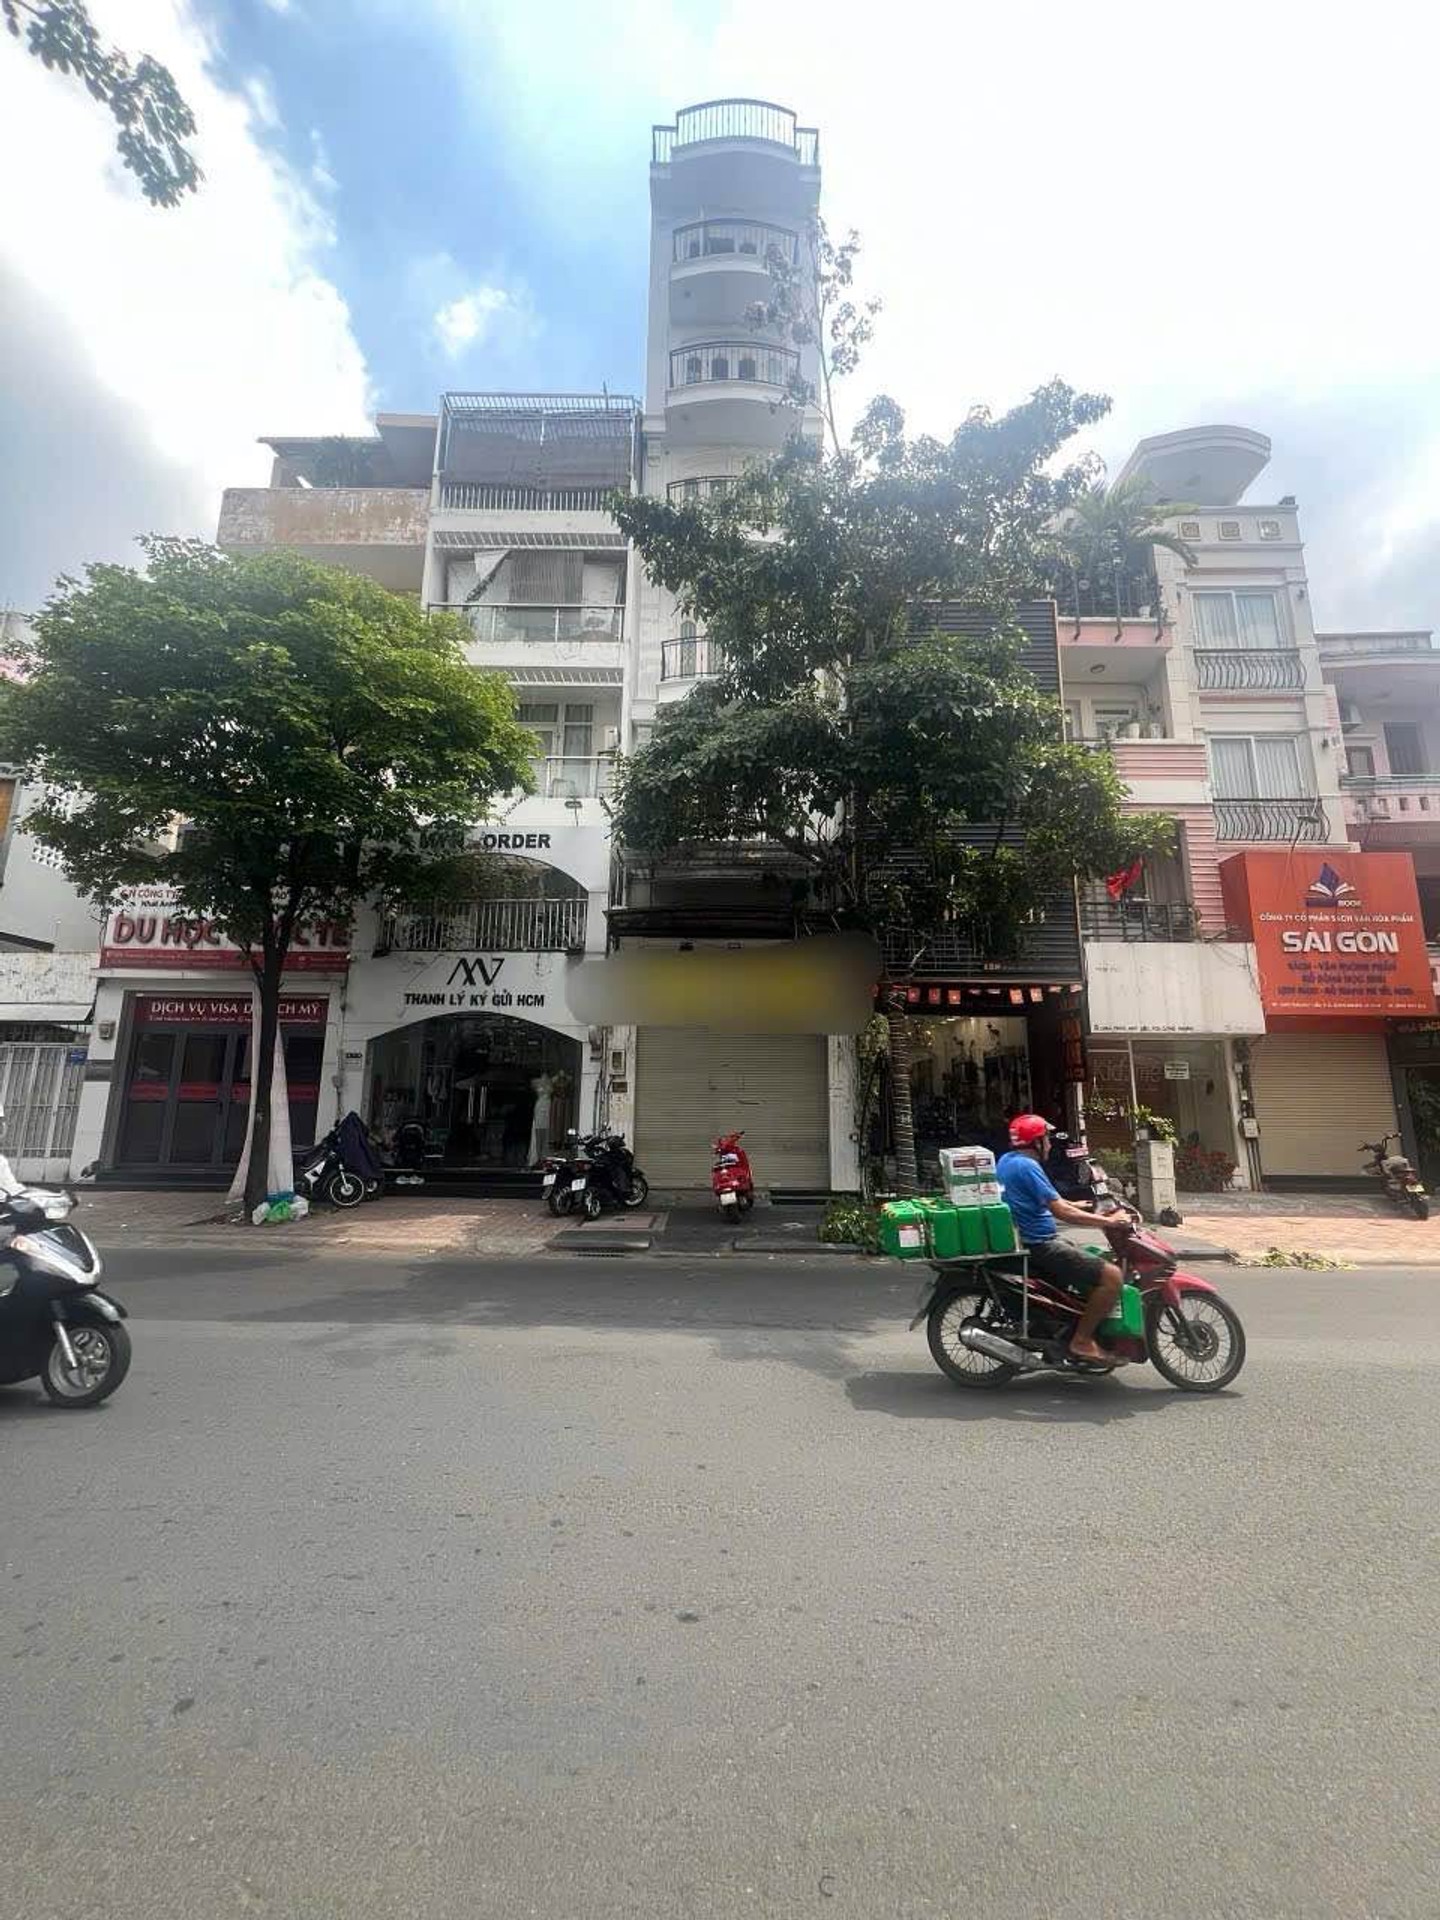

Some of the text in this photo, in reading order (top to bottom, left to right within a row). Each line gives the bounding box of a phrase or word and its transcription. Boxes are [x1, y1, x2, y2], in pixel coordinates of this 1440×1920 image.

[482, 834, 551, 849] ORDER
[161, 917, 220, 949] HỌC
[404, 993, 446, 1006] THANH
[449, 990, 467, 1006] LÝ
[470, 990, 488, 1006] KÝ
[517, 994, 546, 1007] HCM
[151, 1001, 184, 1014] DỊCH
[188, 1002, 206, 1015] VỤ
[210, 1002, 238, 1014] VISA
